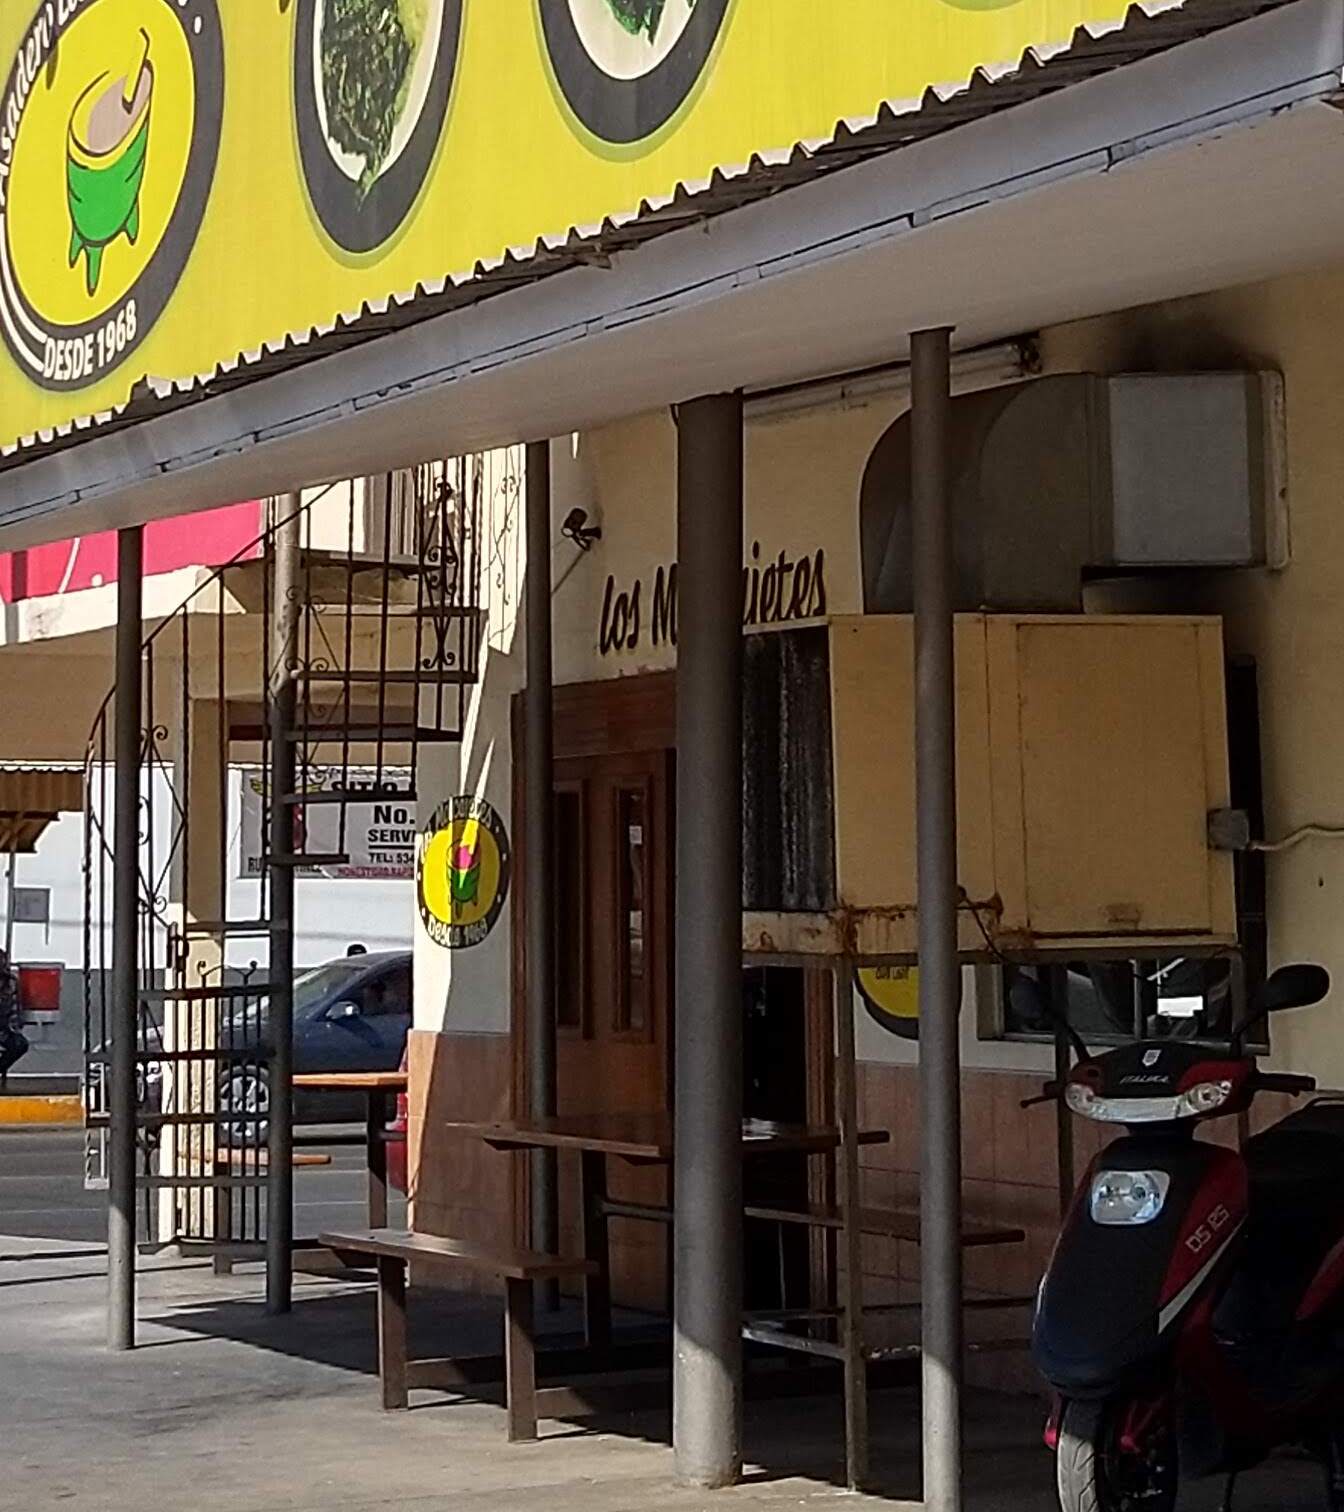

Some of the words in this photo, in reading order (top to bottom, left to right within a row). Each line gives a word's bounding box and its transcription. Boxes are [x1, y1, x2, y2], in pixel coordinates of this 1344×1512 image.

[42, 330, 95, 380] DESDE
[95, 299, 138, 369] 1968
[374, 805, 416, 825] No.
